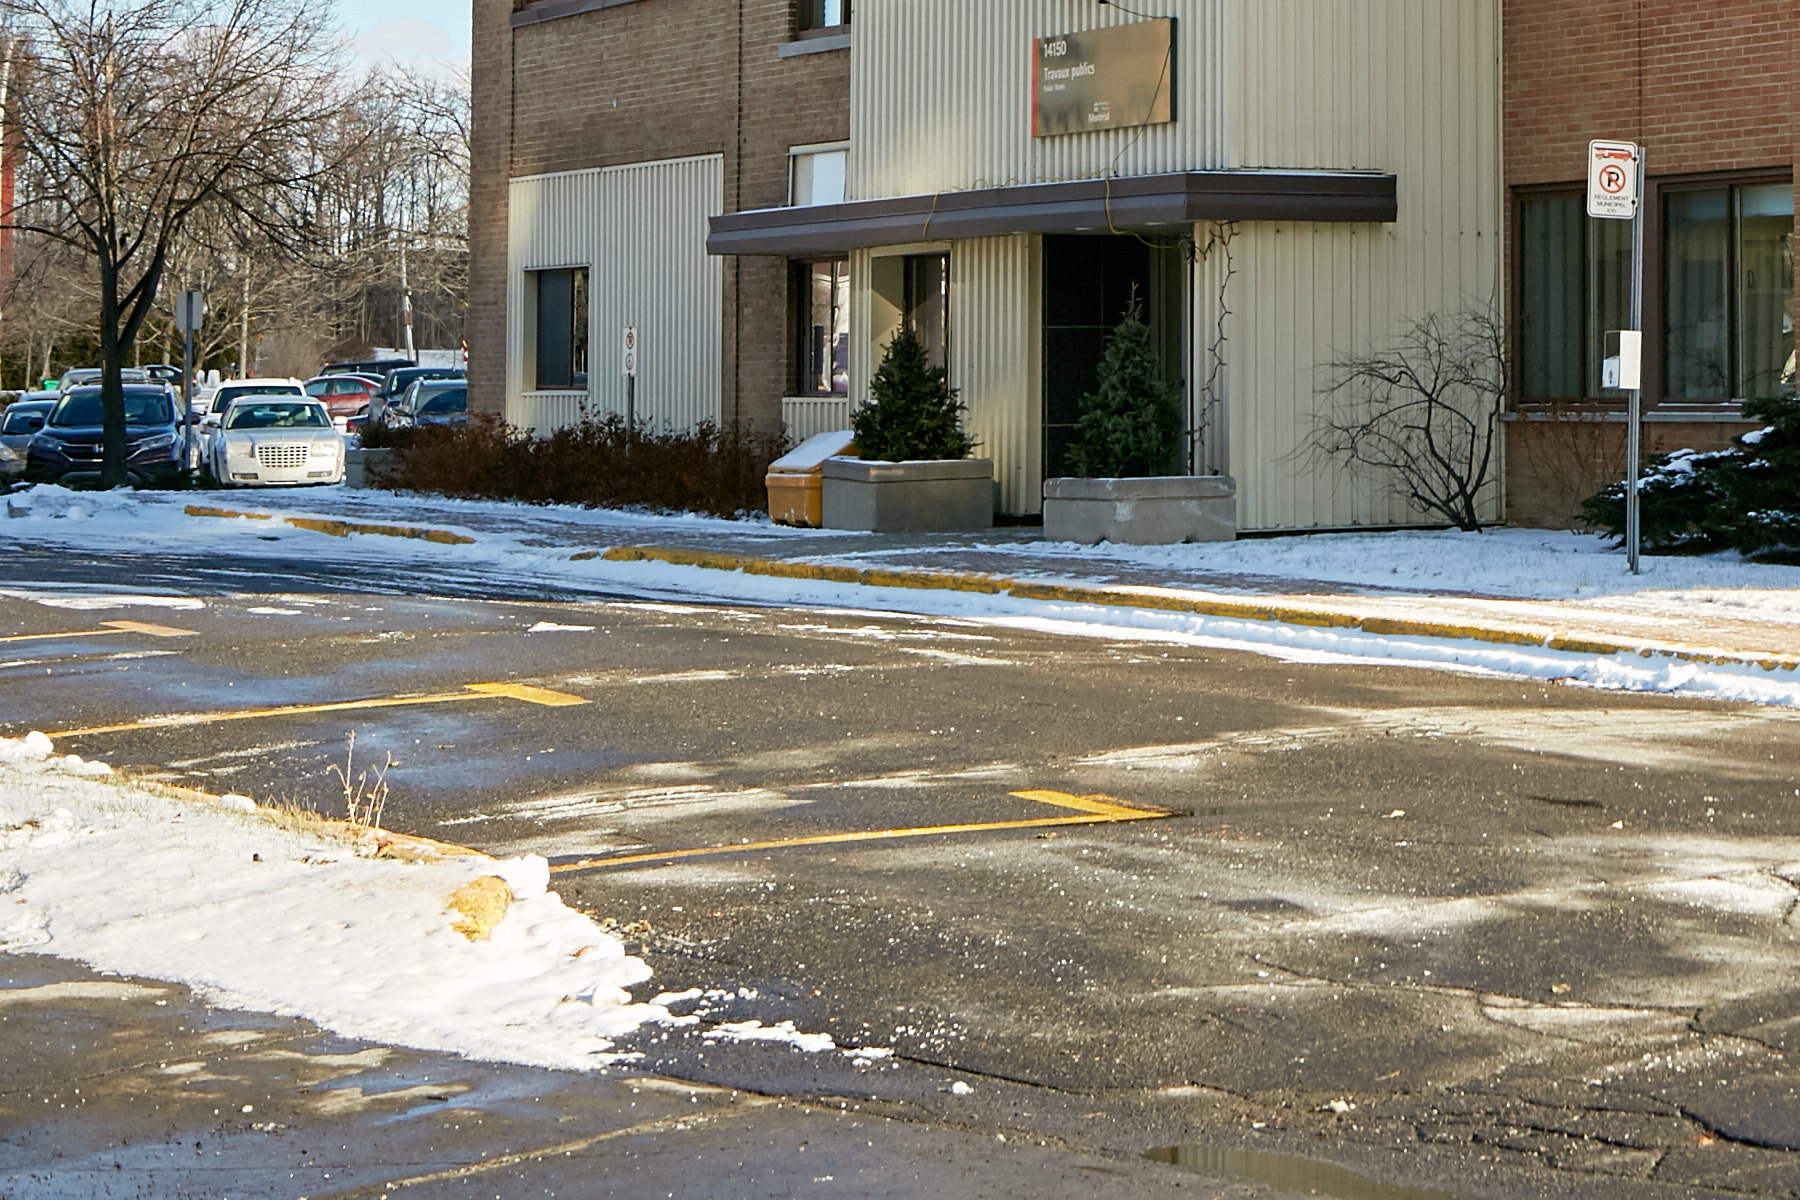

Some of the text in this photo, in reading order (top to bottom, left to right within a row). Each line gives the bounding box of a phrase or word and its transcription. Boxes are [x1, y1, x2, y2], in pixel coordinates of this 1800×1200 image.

[1043, 40, 1067, 57] 14150
[1043, 61, 1096, 80] Travaux publics
